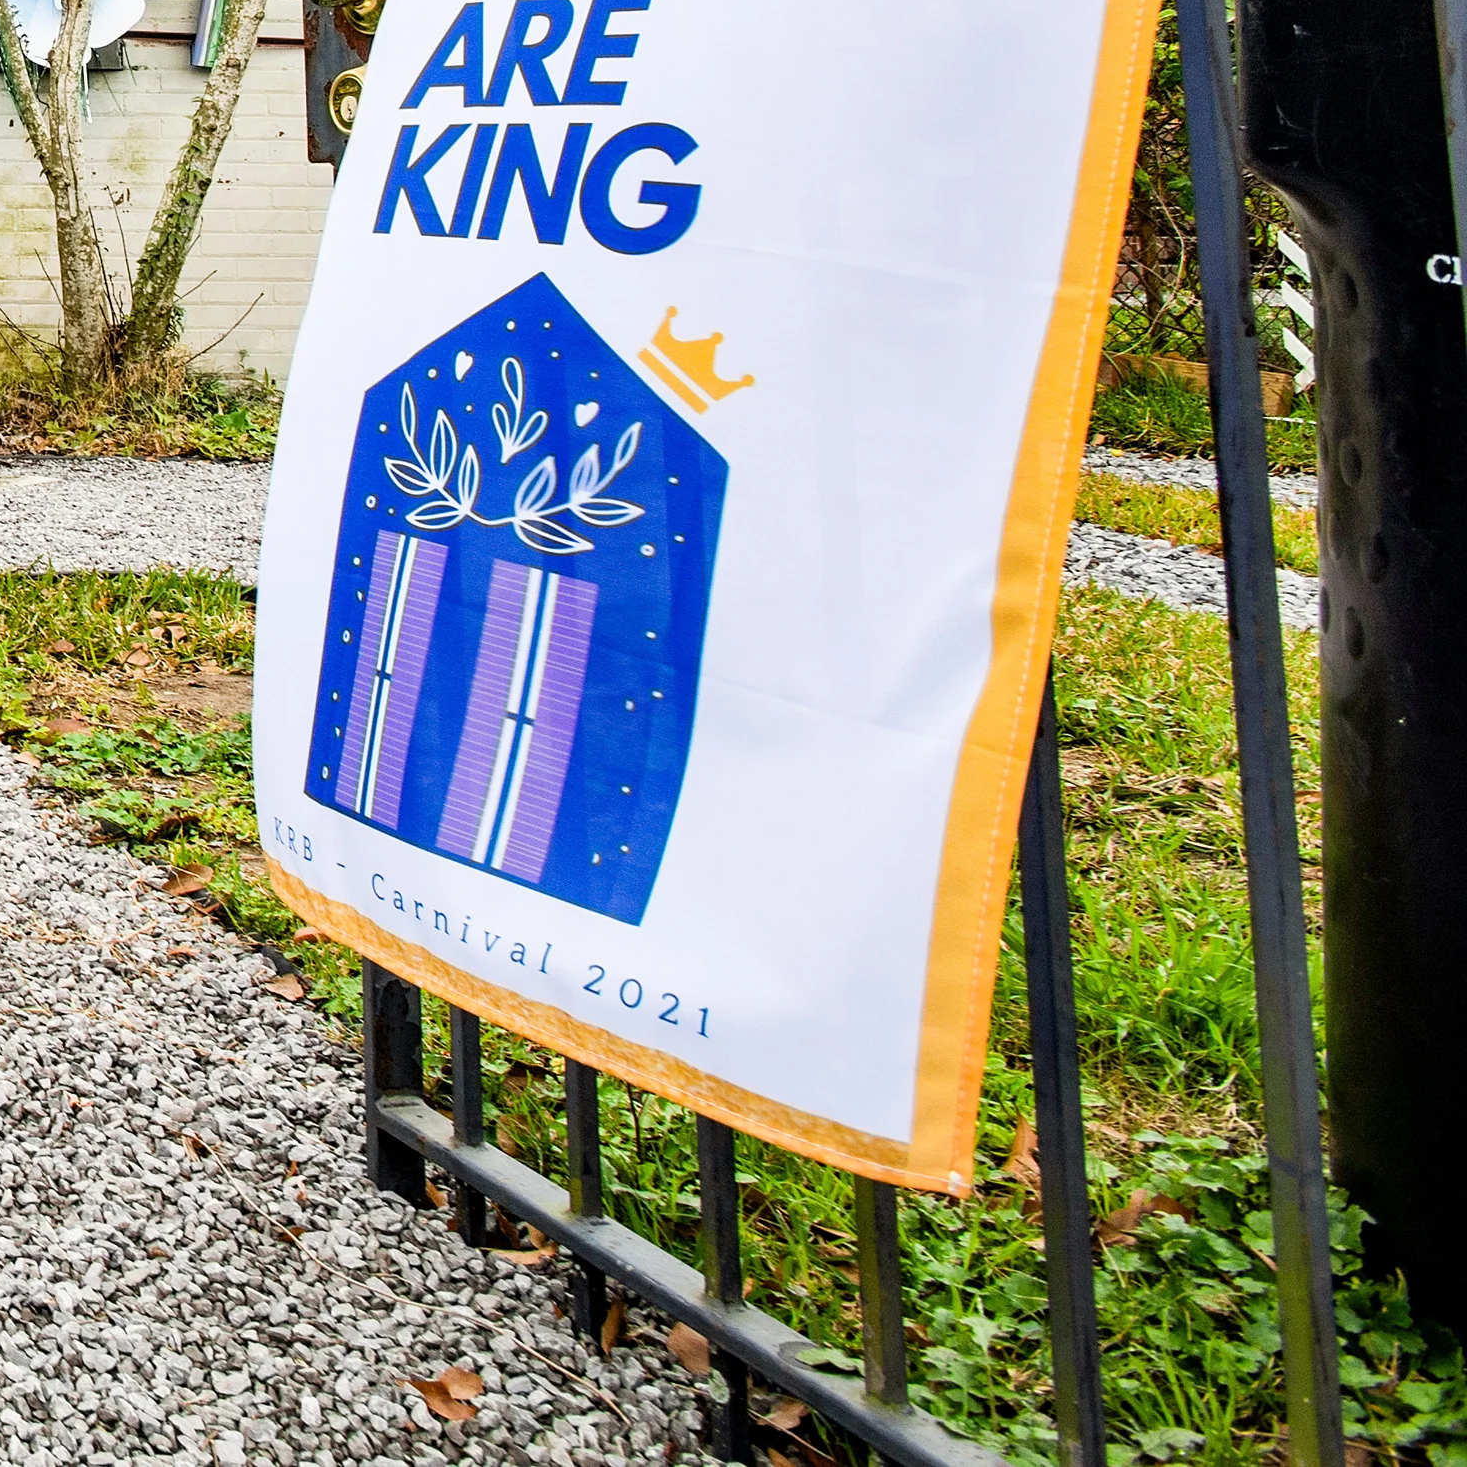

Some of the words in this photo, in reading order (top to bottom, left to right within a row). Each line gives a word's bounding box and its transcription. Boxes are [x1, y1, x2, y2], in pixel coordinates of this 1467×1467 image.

[371, 120, 703, 256] KING
[273, 817, 314, 863] KRB
[371, 872, 553, 975] Carnival
[582, 964, 711, 1040] 2021
